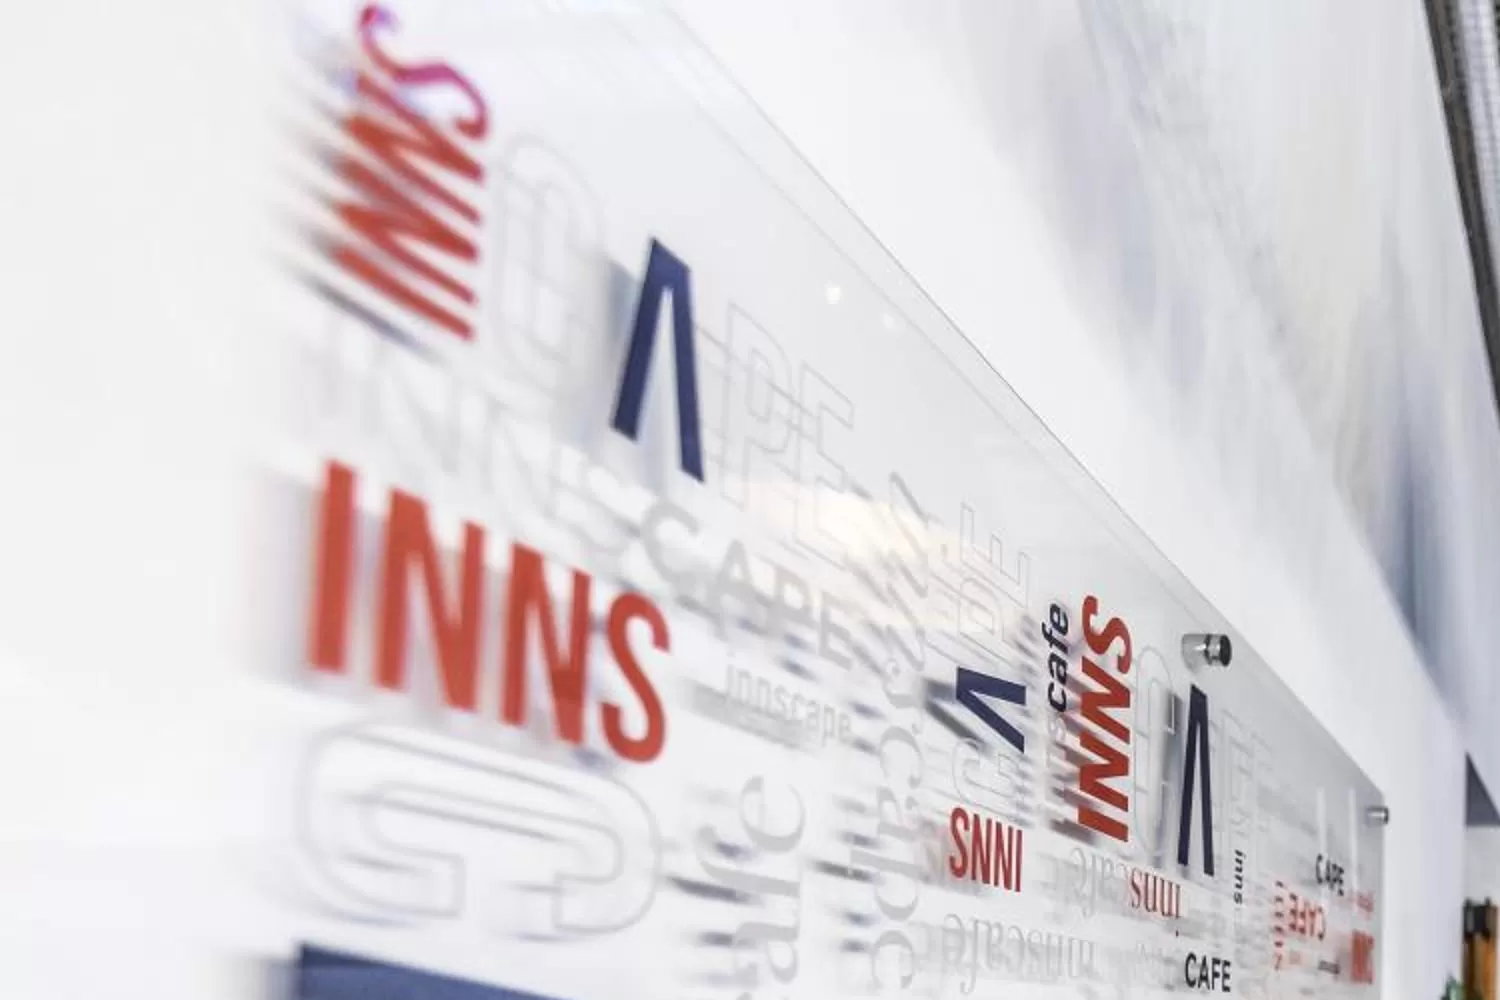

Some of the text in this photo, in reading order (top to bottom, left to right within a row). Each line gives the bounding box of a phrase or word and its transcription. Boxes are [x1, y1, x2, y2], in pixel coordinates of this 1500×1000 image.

[306, 458, 671, 764] INNS
[1077, 594, 1133, 843] INNS
[949, 806, 1024, 893] INNS
[1184, 951, 1232, 994] CAFE
